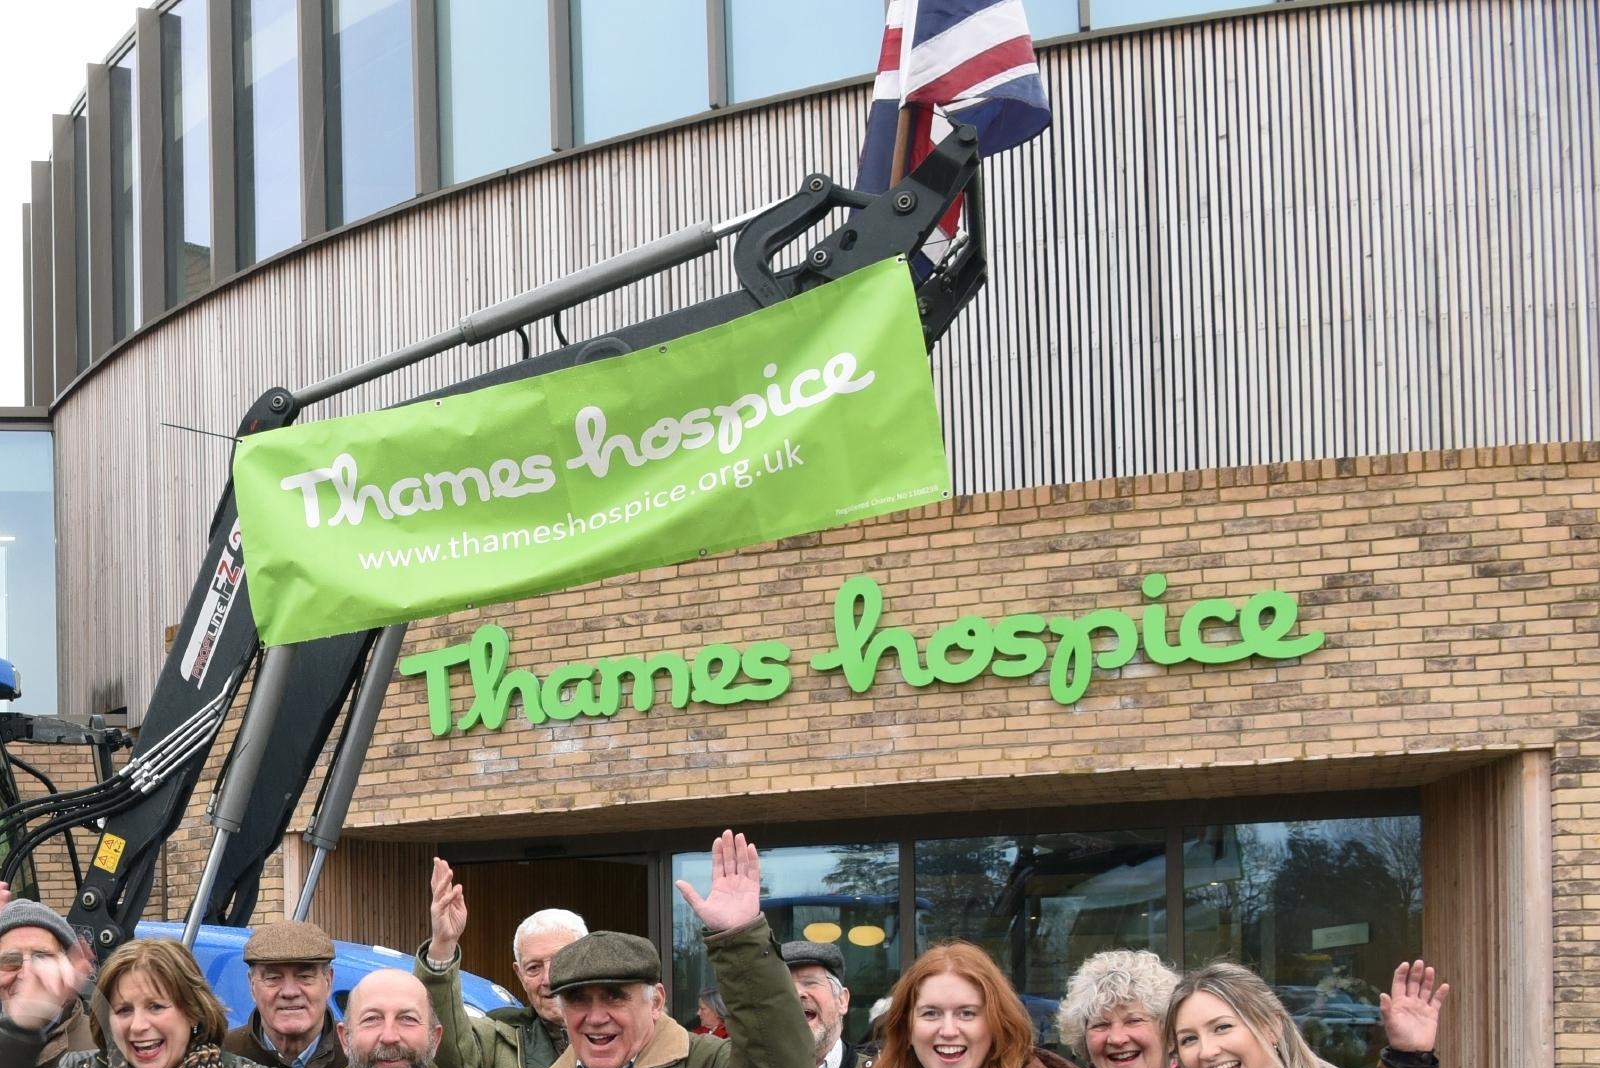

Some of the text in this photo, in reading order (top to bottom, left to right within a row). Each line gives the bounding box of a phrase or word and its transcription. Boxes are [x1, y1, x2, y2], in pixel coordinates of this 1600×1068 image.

[280, 352, 875, 529] Thames hospice
[357, 440, 804, 571] www.thameshospice.org.uk
[401, 573, 1325, 736] Thames hospice
